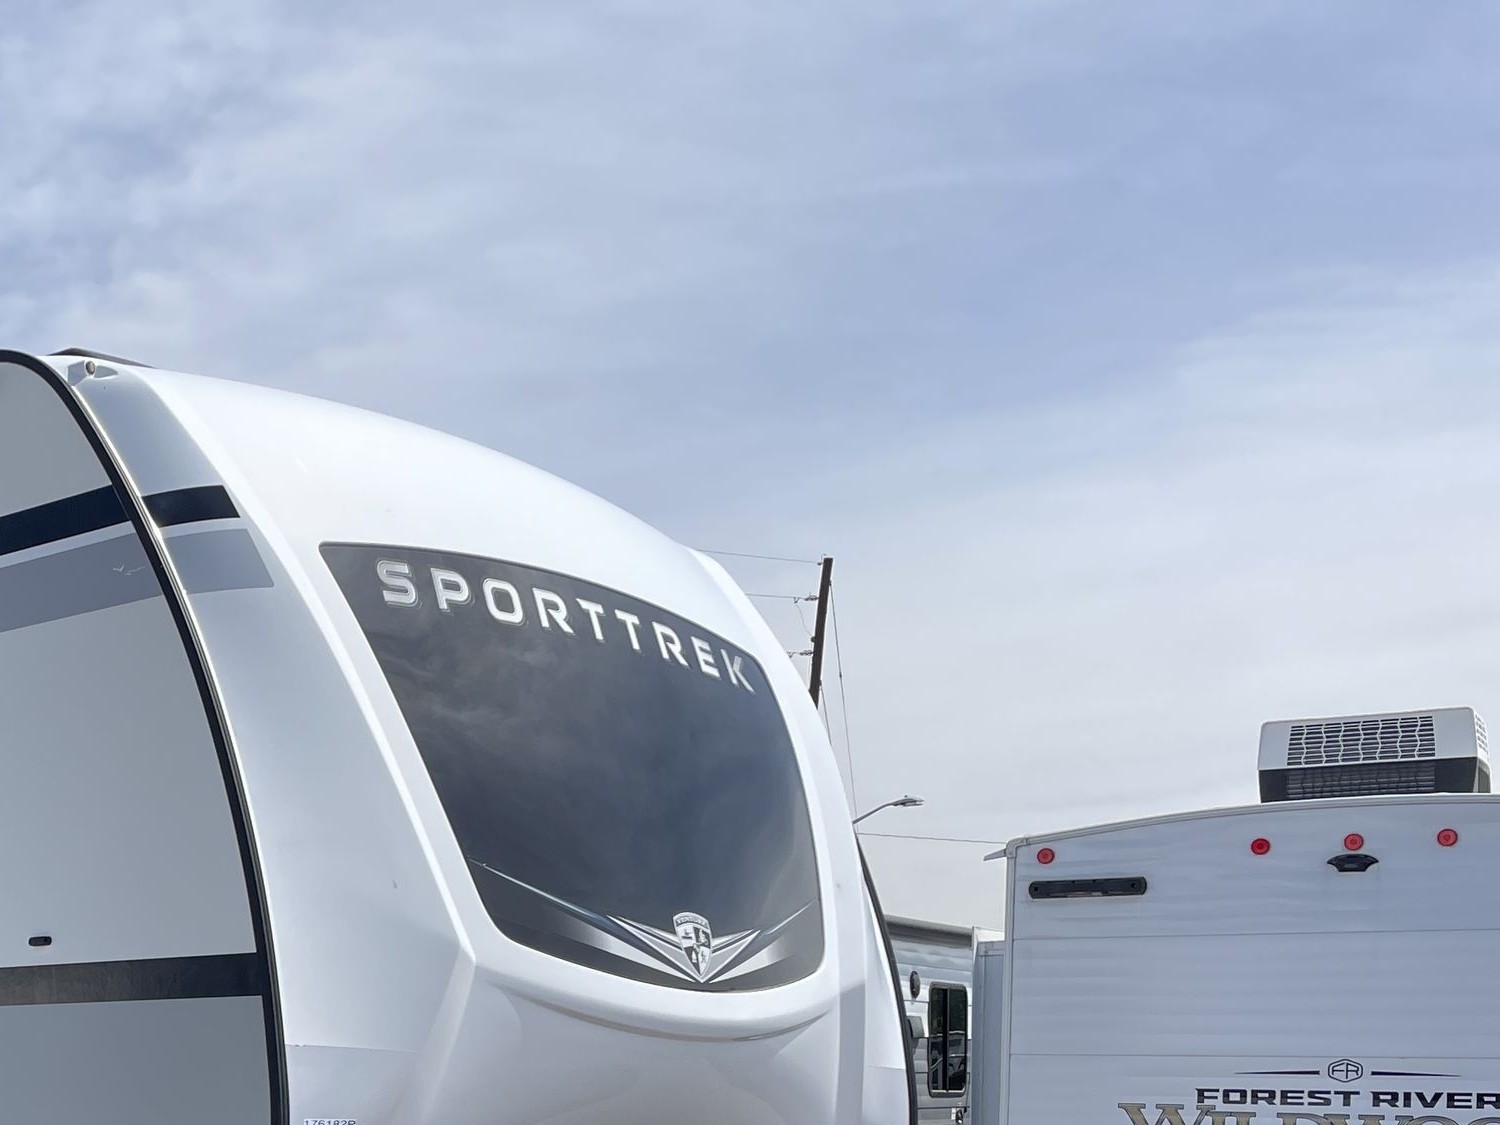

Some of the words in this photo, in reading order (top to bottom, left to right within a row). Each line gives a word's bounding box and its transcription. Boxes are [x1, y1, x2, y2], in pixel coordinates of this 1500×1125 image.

[376, 559, 755, 694] SPORTTREK
[1195, 1088, 1360, 1107] FOREST
[1370, 1091, 1500, 1110] RIVER
